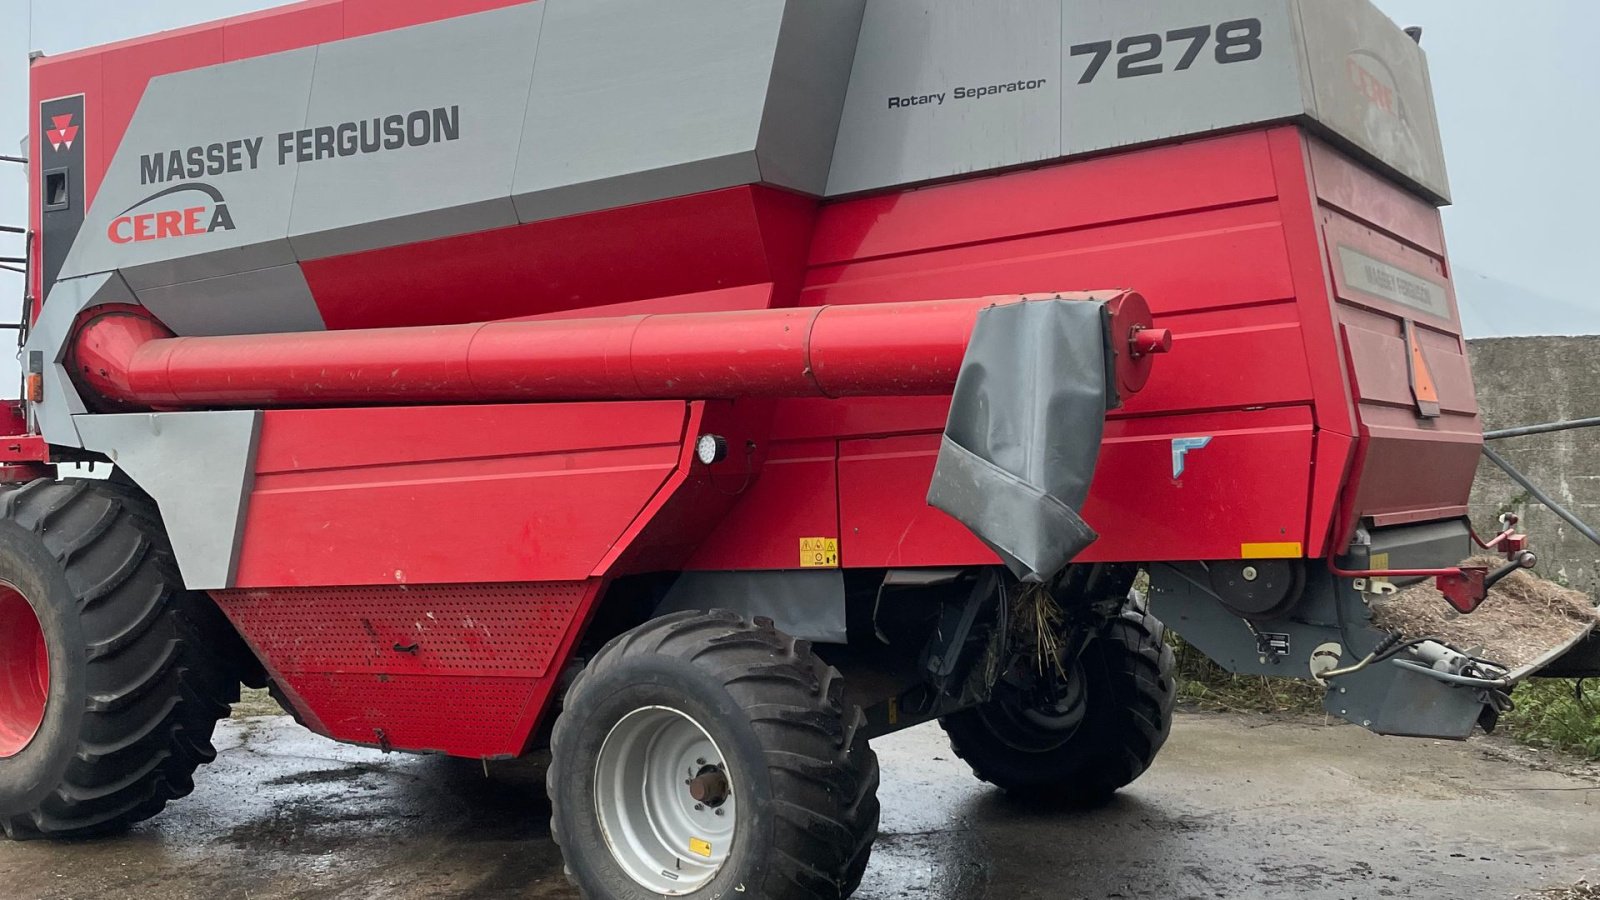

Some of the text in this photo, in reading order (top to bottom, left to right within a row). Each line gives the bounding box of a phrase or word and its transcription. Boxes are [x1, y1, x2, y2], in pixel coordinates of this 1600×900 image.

[1070, 18, 1262, 85] 7278
[888, 78, 1046, 109] Rotary Separator
[140, 105, 459, 185] MASSEY FERGUSON
[107, 203, 236, 244] CEREA
